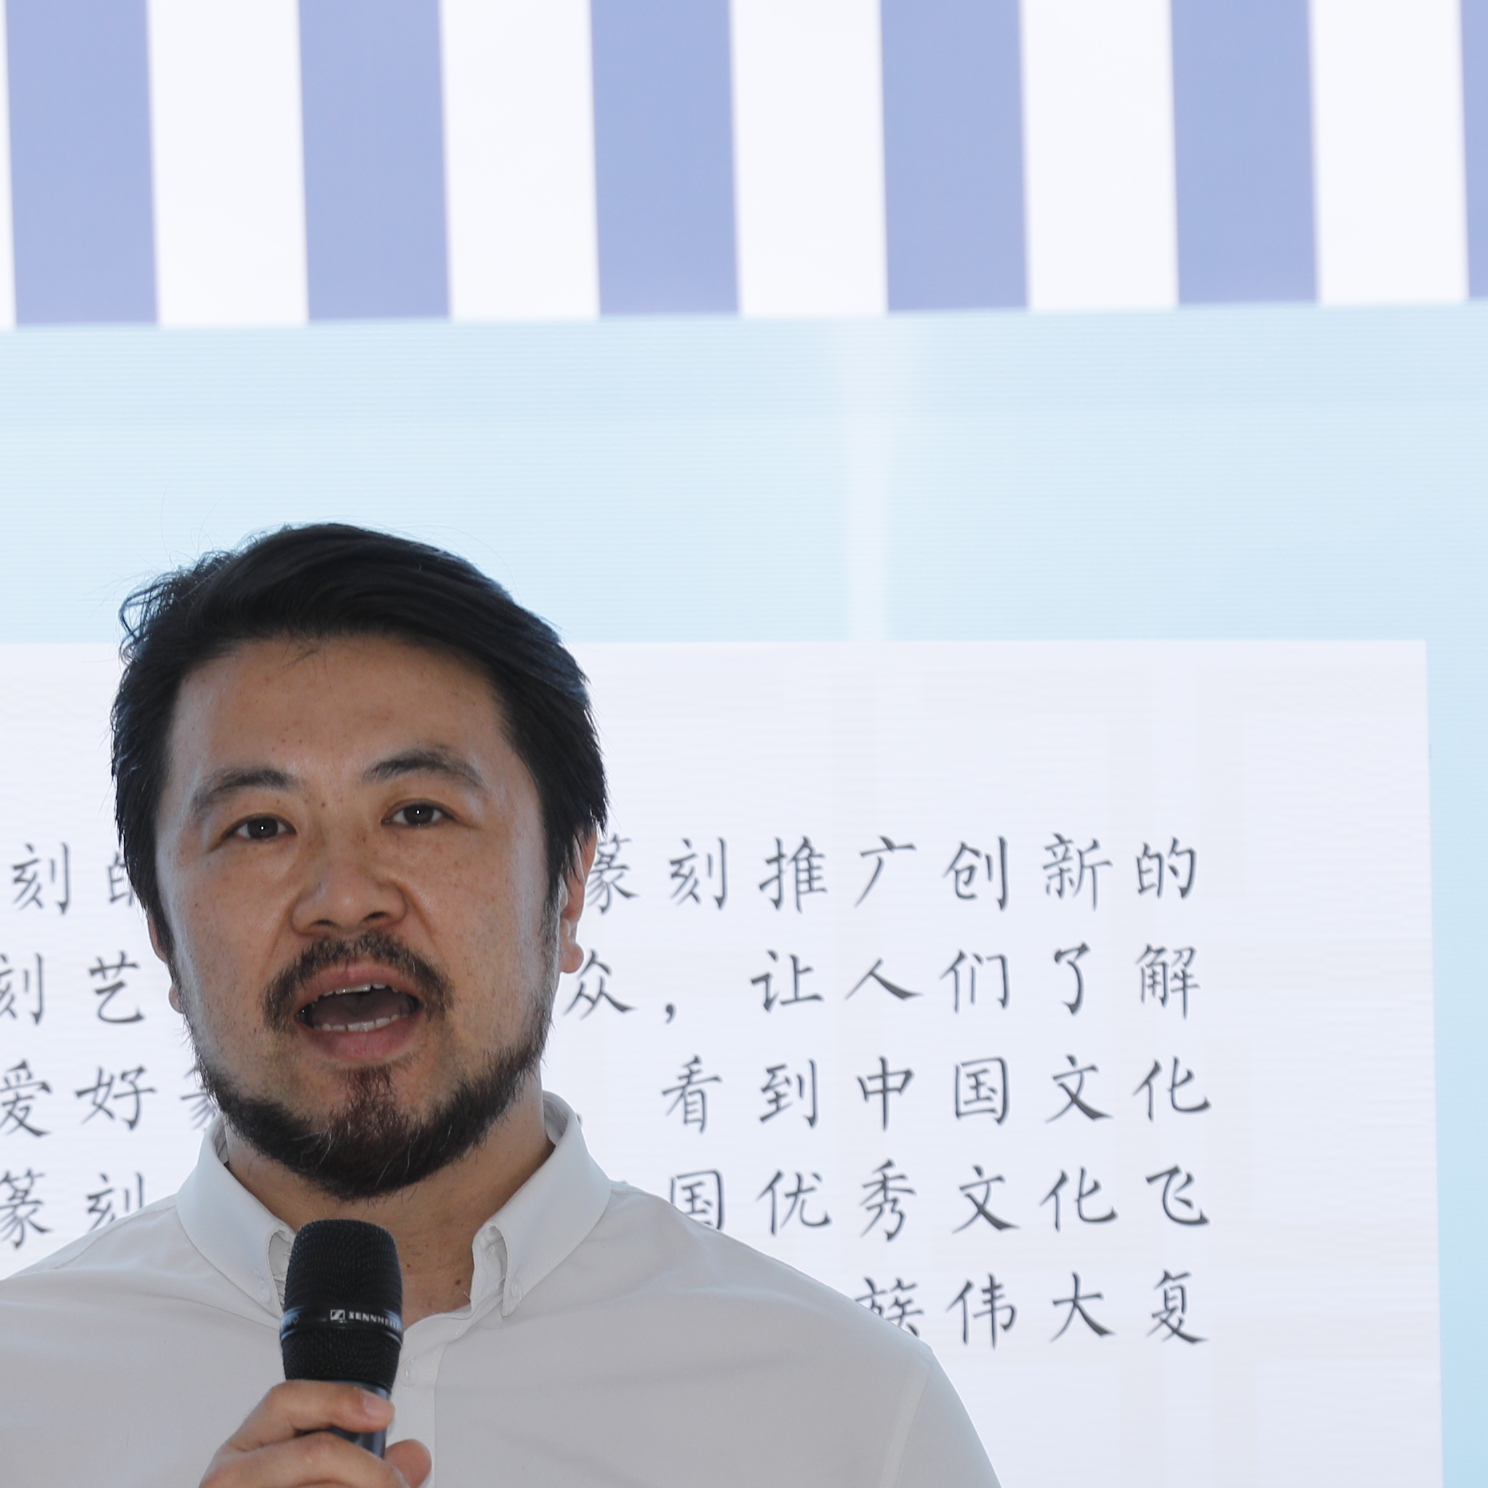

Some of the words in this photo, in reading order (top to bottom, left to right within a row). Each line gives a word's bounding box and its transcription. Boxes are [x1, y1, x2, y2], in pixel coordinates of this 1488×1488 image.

[562, 942, 1200, 1025] 众，让人们了解
[661, 1054, 1211, 1133] 看到中国文化
[667, 1158, 1210, 1243] 国优秀文化飞
[854, 1270, 1208, 1348] 族伟大复
